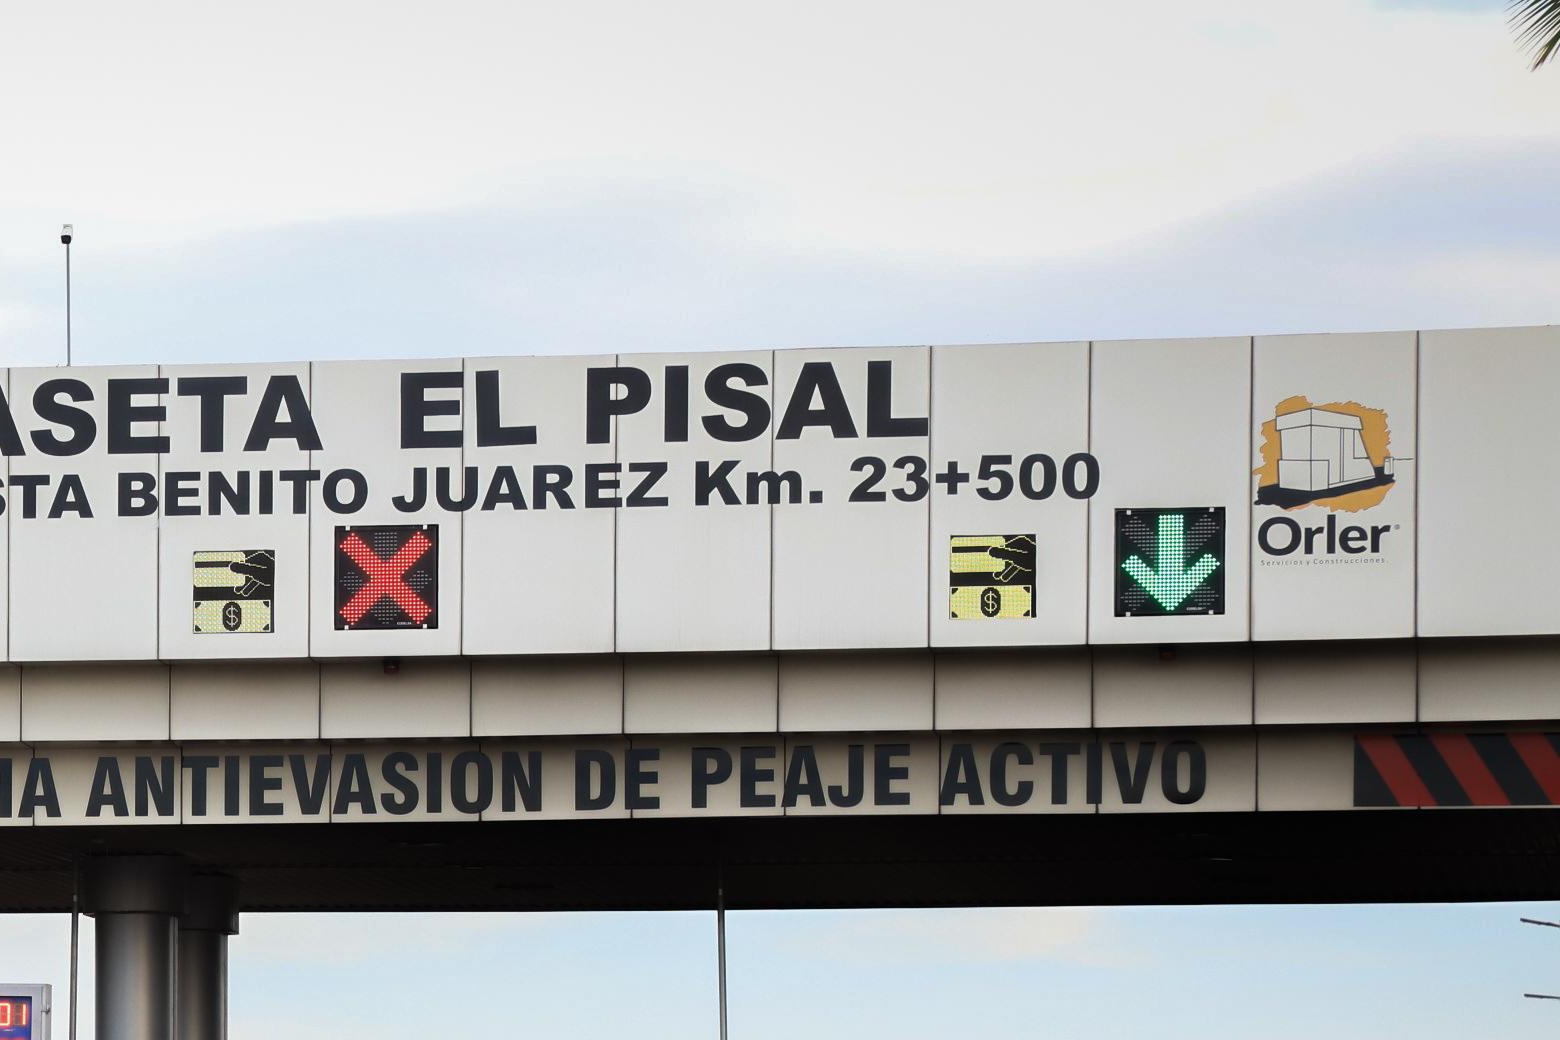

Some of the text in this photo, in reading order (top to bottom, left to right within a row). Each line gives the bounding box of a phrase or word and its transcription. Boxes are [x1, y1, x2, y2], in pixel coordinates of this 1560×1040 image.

[400, 369, 537, 449] EL
[586, 360, 929, 445] PISAL
[117, 468, 369, 518] BENITO
[391, 462, 669, 513] JUAREZ
[694, 459, 823, 506] Km.
[848, 453, 1100, 503] 23+500
[1258, 514, 1391, 556] Orler
[1260, 559, 1303, 567] Servicios
[85, 749, 542, 818] ANTIEVASION
[574, 748, 660, 811] DE
[691, 743, 911, 809] PEAJE
[941, 739, 1207, 806] ACTIVO
